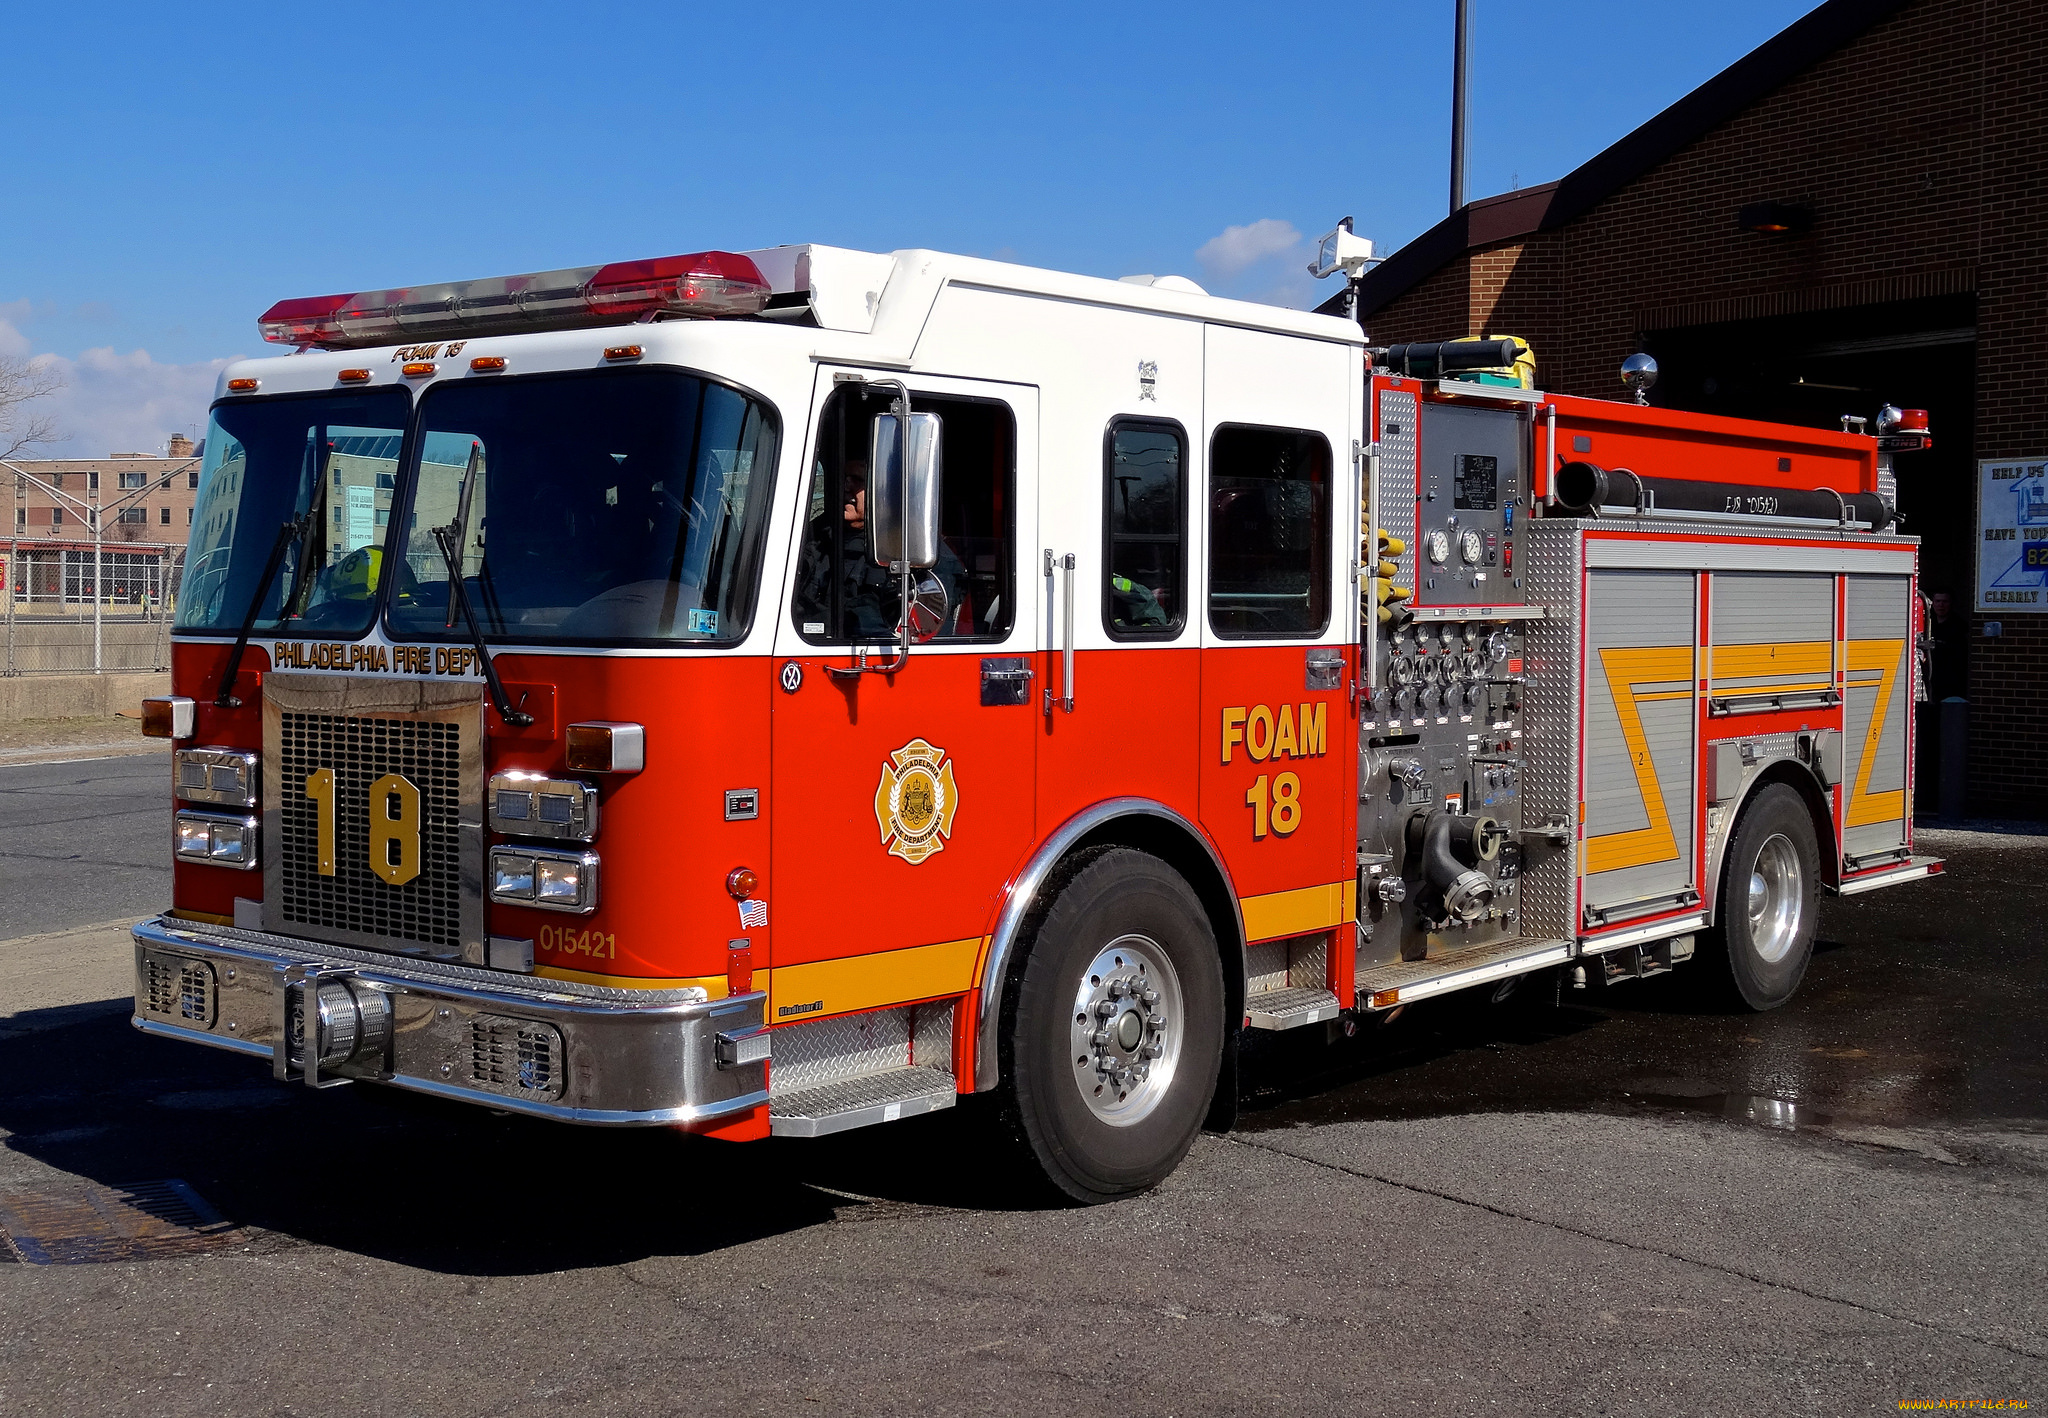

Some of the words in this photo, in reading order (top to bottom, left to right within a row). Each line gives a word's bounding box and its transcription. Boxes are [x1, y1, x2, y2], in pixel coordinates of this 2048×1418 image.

[391, 344, 444, 362] FOAM
[444, 341, 467, 358] 18
[1992, 466, 2023, 480] HELP
[2028, 466, 2045, 478] US
[1985, 528, 2016, 541] HAVE
[2027, 548, 2048, 565] 82
[1985, 590, 2039, 603] CLEARLY
[275, 642, 389, 672] PHILADELPHIA
[393, 646, 432, 675] FIRE
[1770, 647, 1775, 660] 4
[1220, 702, 1327, 766] FOAM
[1872, 728, 1878, 740] 6
[1638, 752, 1644, 766] 2
[895, 759, 939, 781] PHILADELPHIA
[1245, 771, 1302, 842] 18
[306, 767, 421, 887] 18
[891, 819, 904, 837] FIRE
[903, 815, 942, 844] DEPARTMENT
[539, 924, 616, 960] 015421
[779, 1003, 814, 1016] Gladiator
